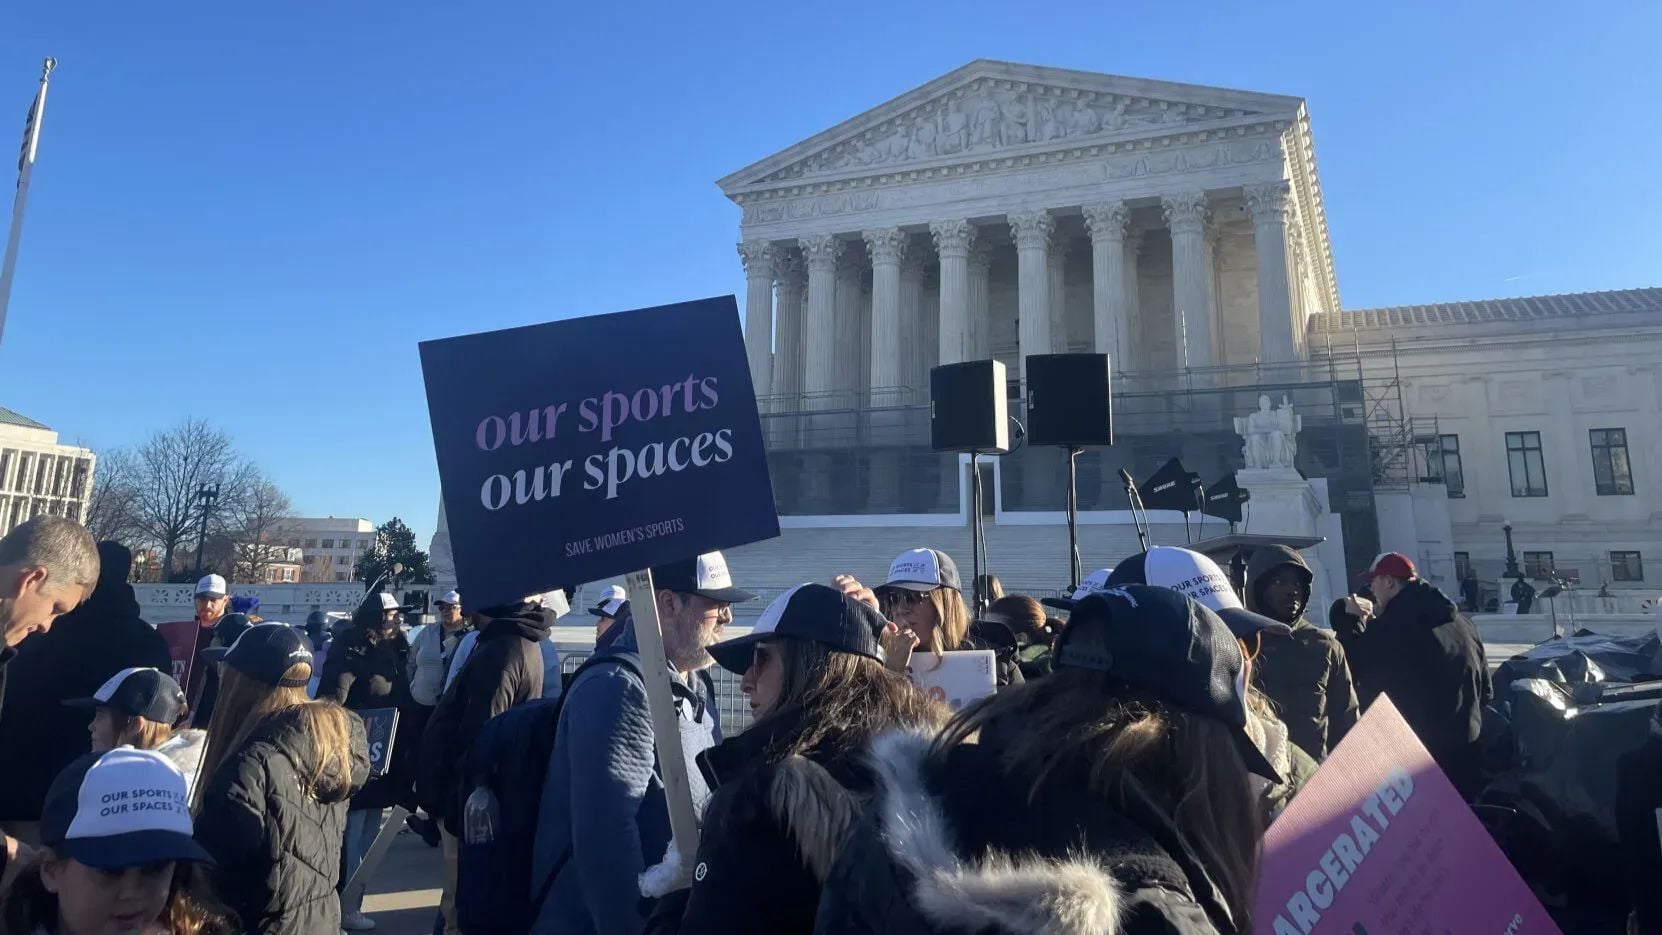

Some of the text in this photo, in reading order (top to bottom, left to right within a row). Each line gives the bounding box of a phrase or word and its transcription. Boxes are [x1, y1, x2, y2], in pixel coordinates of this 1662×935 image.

[476, 373, 719, 451] our sports
[480, 428, 733, 510] our spaces
[1153, 480, 1176, 493] SHURE
[565, 518, 685, 557] SAVE WOMEN'S SPORTS
[100, 801, 173, 817] OUR SPACES
[101, 789, 172, 804] OUR SPORTS
